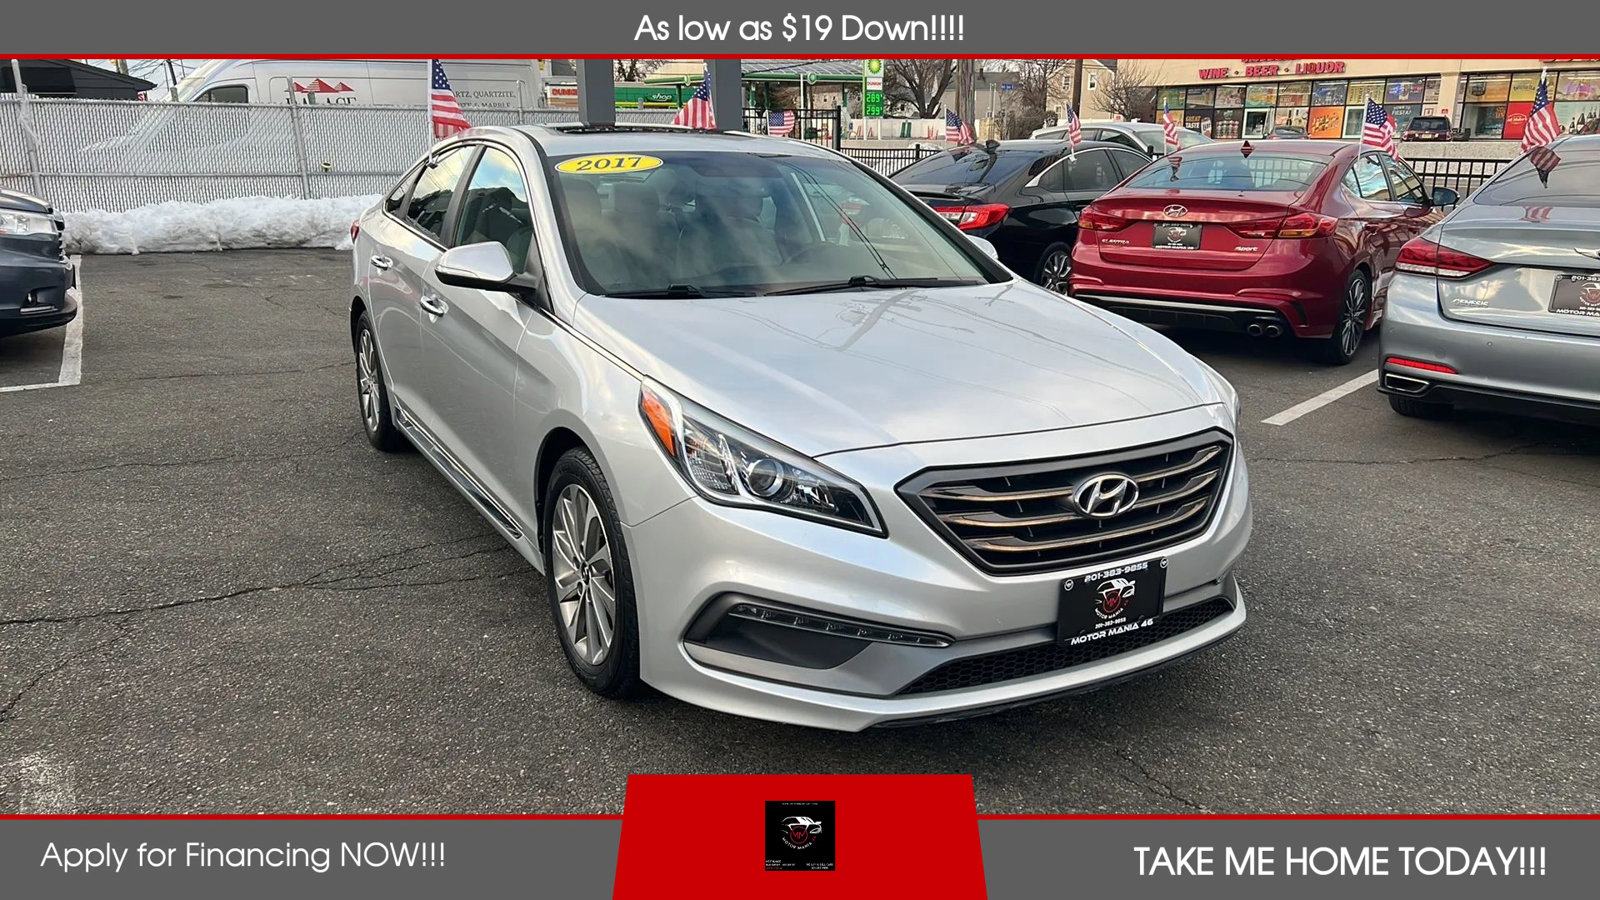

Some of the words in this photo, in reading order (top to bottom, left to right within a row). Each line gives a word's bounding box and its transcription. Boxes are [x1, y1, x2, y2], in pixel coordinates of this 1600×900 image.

[1199, 68, 1228, 79] WINE
[1245, 65, 1279, 77] BEER
[1295, 62, 1344, 75] LIQUOR
[652, 93, 672, 102] shop
[576, 157, 642, 171] 2017
[1084, 562, 1148, 582] 201-383-9855
[1070, 630, 1106, 646] MOTOR
[1107, 619, 1140, 637] MANIA
[1140, 618, 1154, 628] 46
